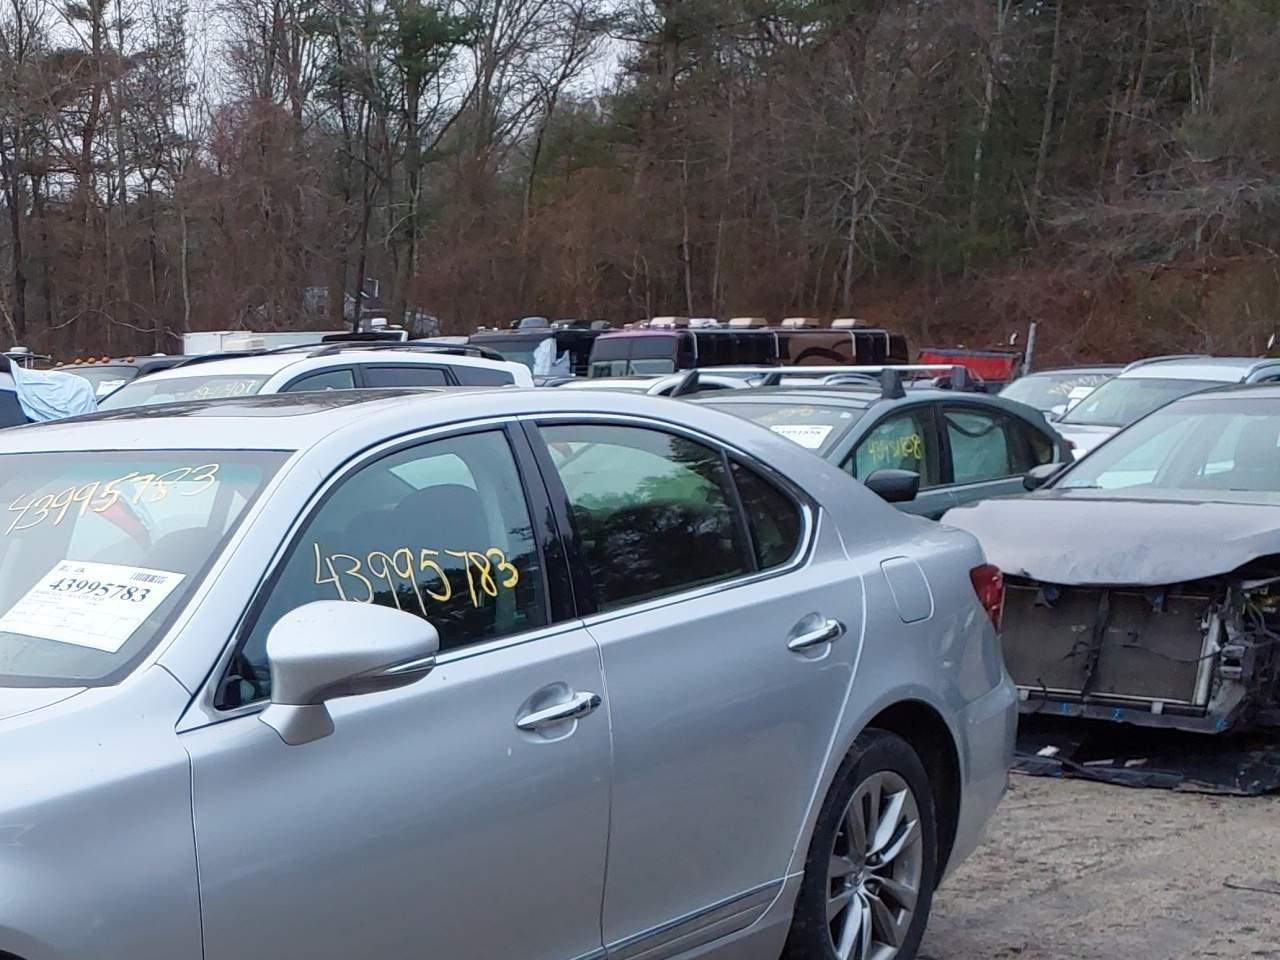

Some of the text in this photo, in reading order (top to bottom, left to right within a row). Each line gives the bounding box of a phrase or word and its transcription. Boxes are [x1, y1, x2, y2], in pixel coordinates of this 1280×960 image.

[5, 463, 219, 535] 43995783
[49, 577, 151, 603] 43995783
[313, 543, 519, 616] 43995783
